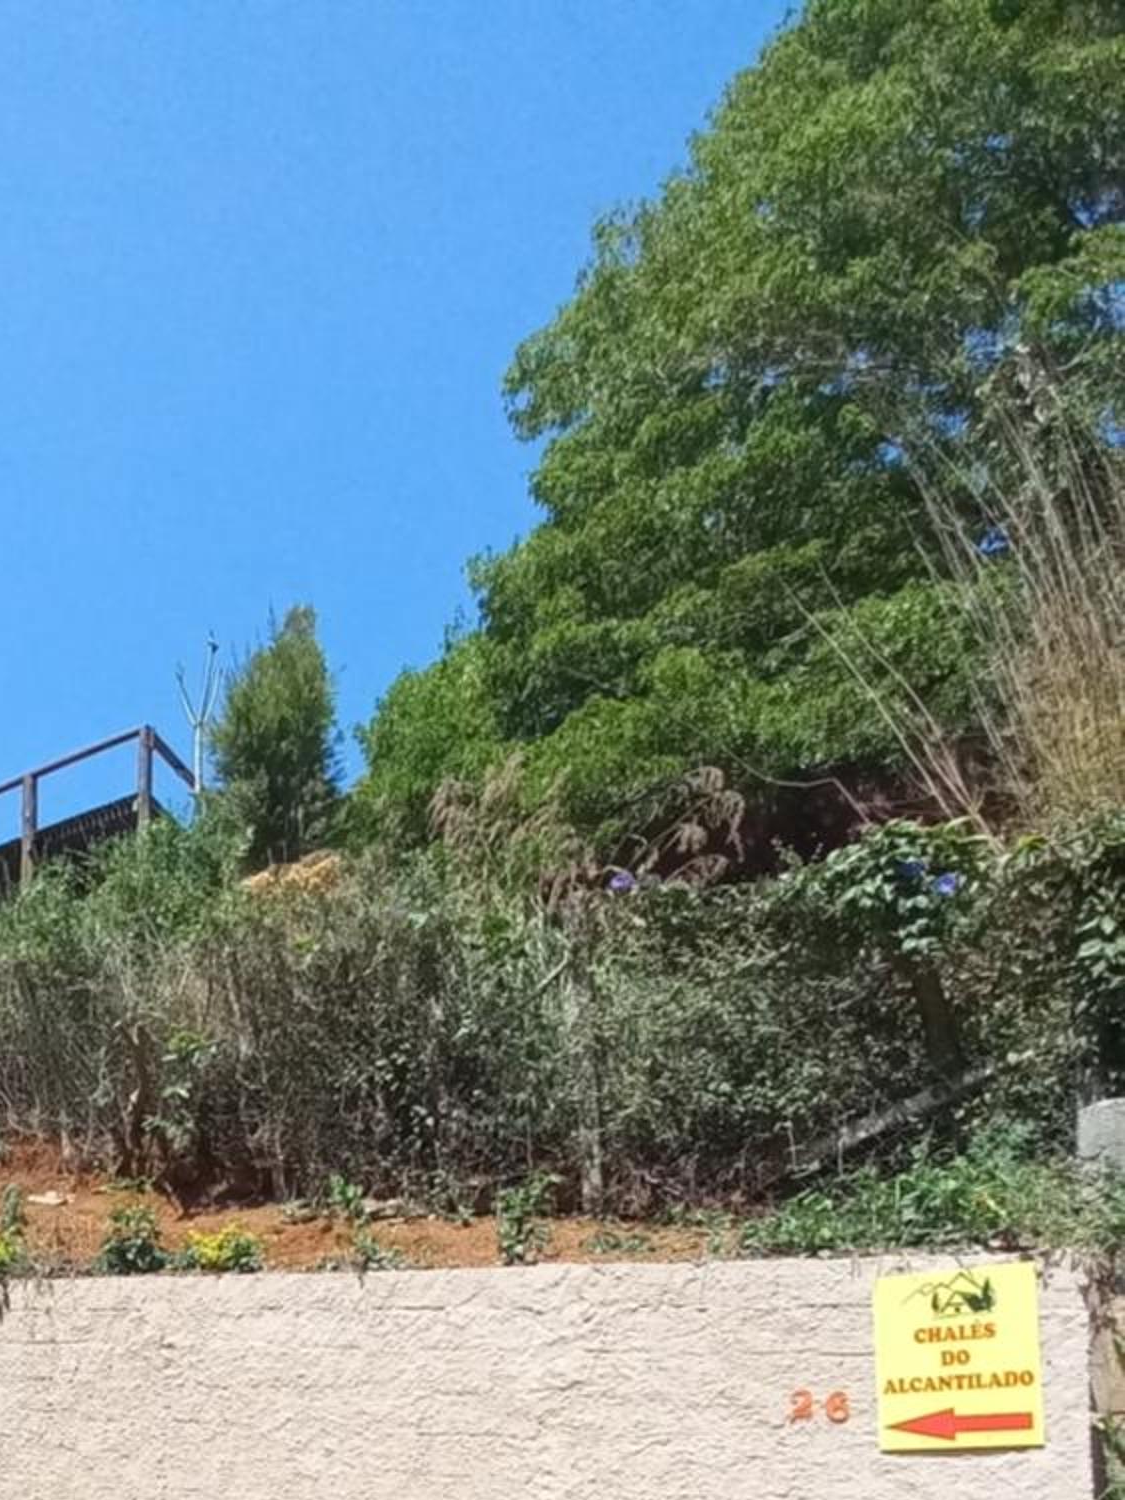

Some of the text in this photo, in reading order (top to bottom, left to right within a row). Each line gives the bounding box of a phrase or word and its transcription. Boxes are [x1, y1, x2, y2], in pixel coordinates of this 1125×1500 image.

[941, 1350, 971, 1366] DO
[883, 1370, 1034, 1395] ALCANTILADO
[790, 1389, 850, 1425] 26
